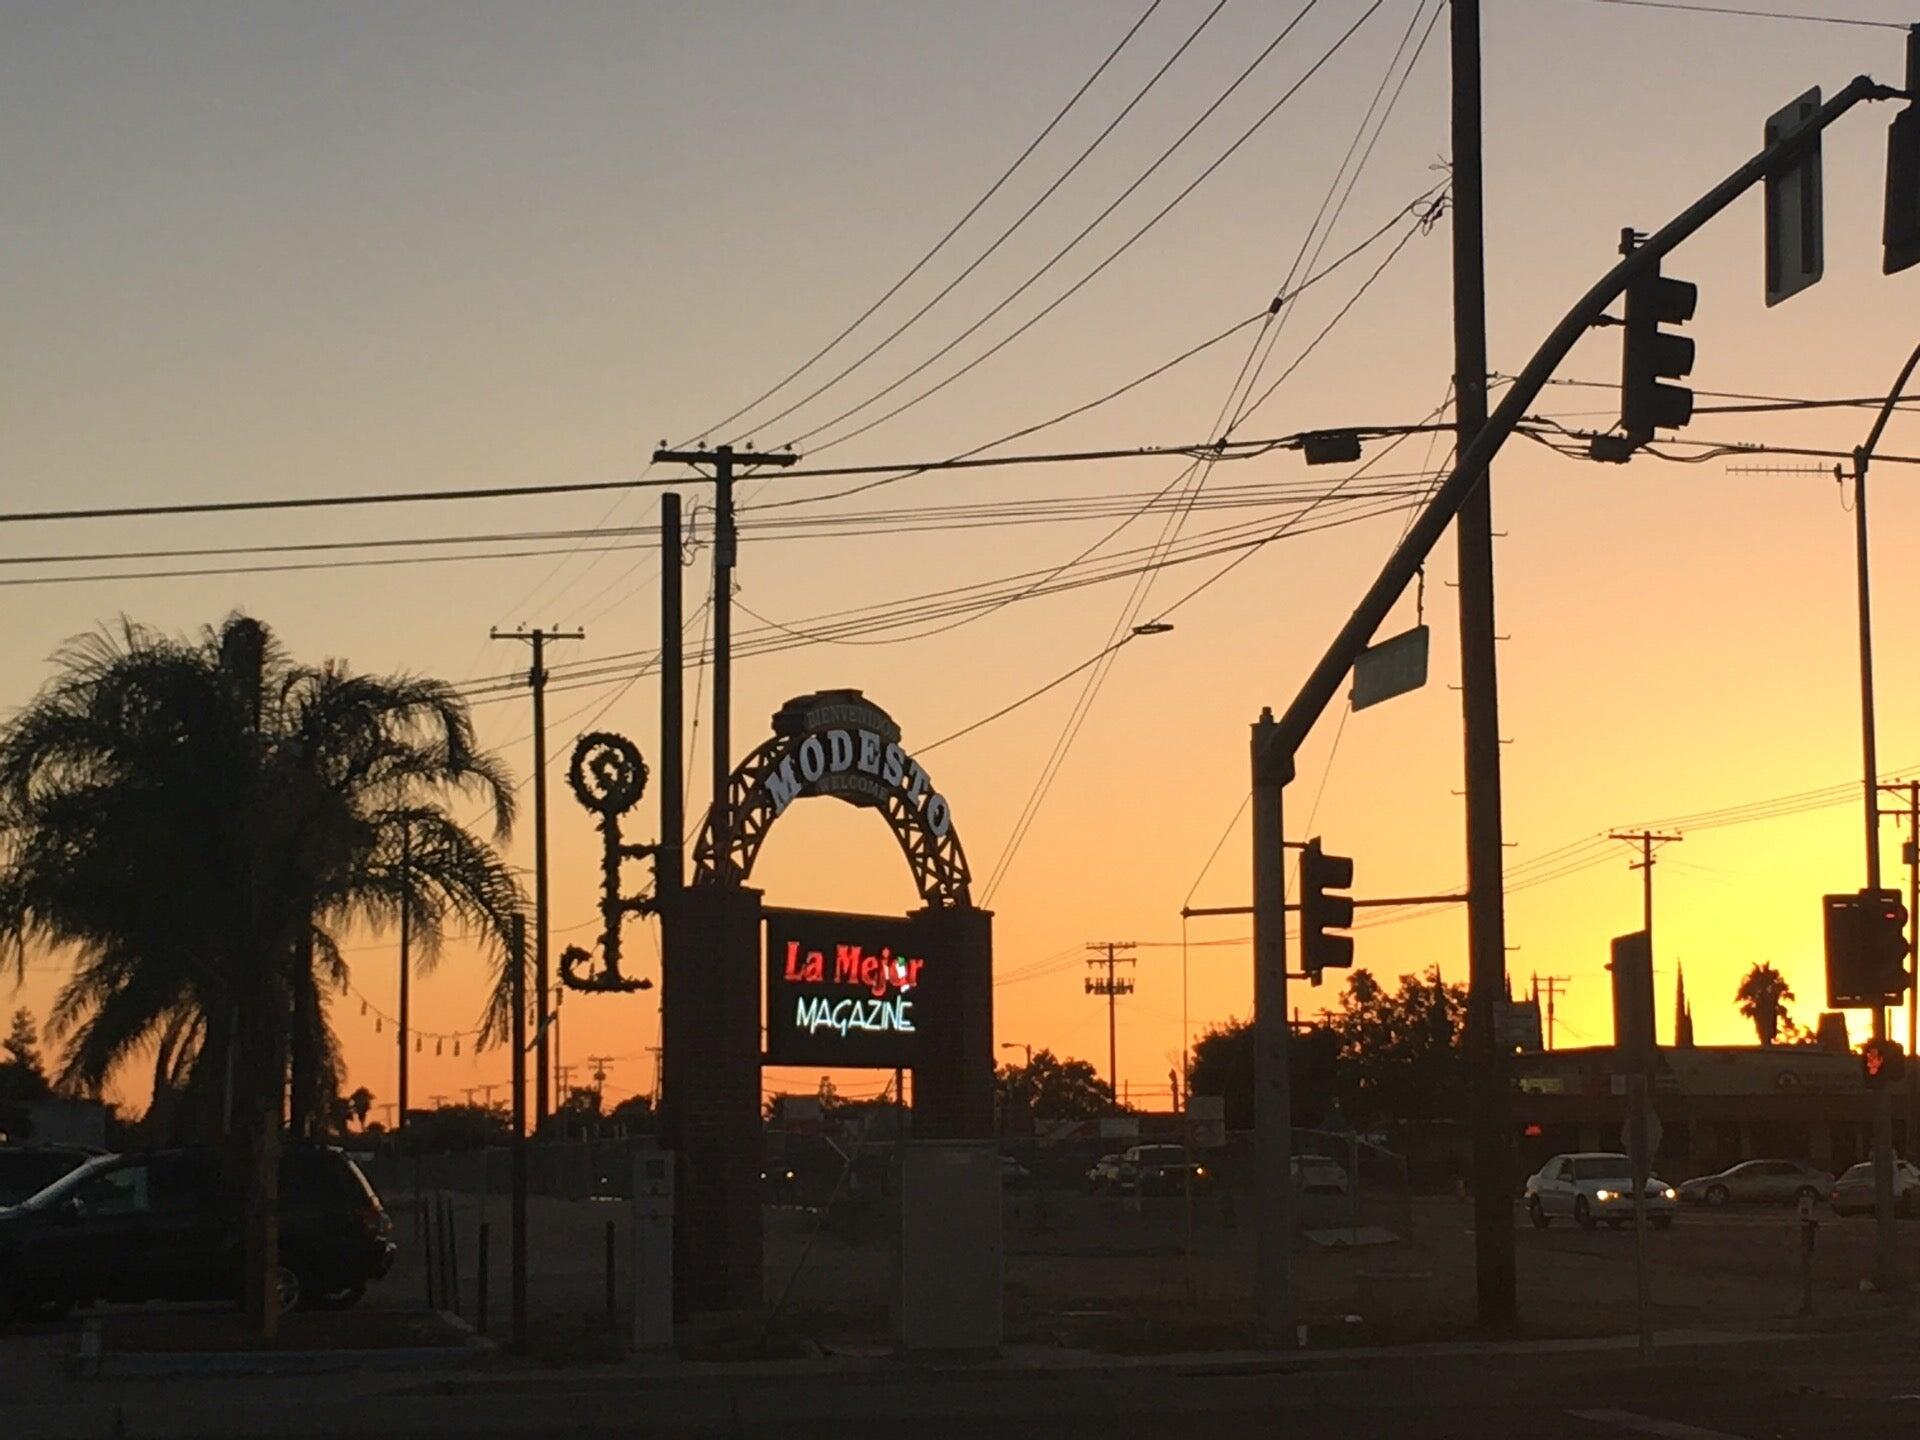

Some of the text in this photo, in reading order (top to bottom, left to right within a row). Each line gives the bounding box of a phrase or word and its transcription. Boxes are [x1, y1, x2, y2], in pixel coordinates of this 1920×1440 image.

[764, 729, 951, 837] MODESTO
[815, 774, 890, 801] WELCOME
[785, 941, 924, 996] La Mejor
[796, 995, 916, 1037] MAGAZINE
